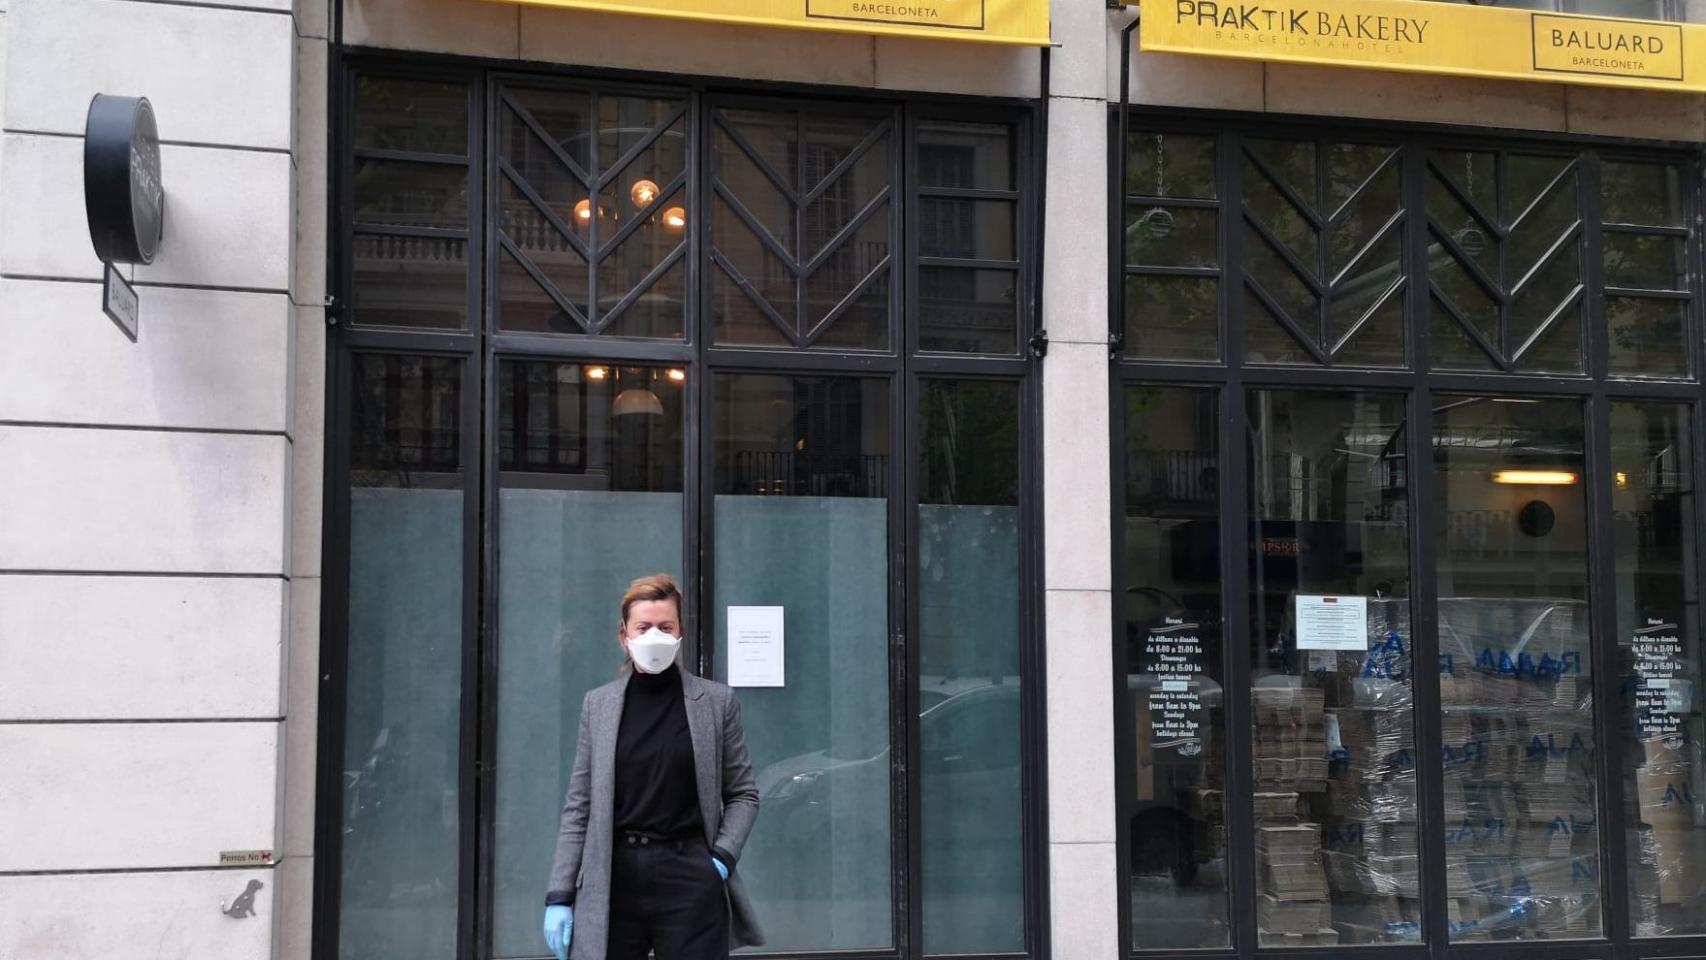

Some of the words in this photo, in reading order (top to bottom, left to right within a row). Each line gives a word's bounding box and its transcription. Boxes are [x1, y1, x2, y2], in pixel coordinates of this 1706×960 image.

[852, 3, 938, 18] BARCELONETA
[1177, 0, 1309, 35] PRAKTIK
[1316, 11, 1429, 43] BAKERY
[1552, 29, 1663, 54] BALUARD
[1572, 56, 1645, 70] BARCELONETA
[221, 854, 246, 862] Perros
[248, 853, 259, 861] No
